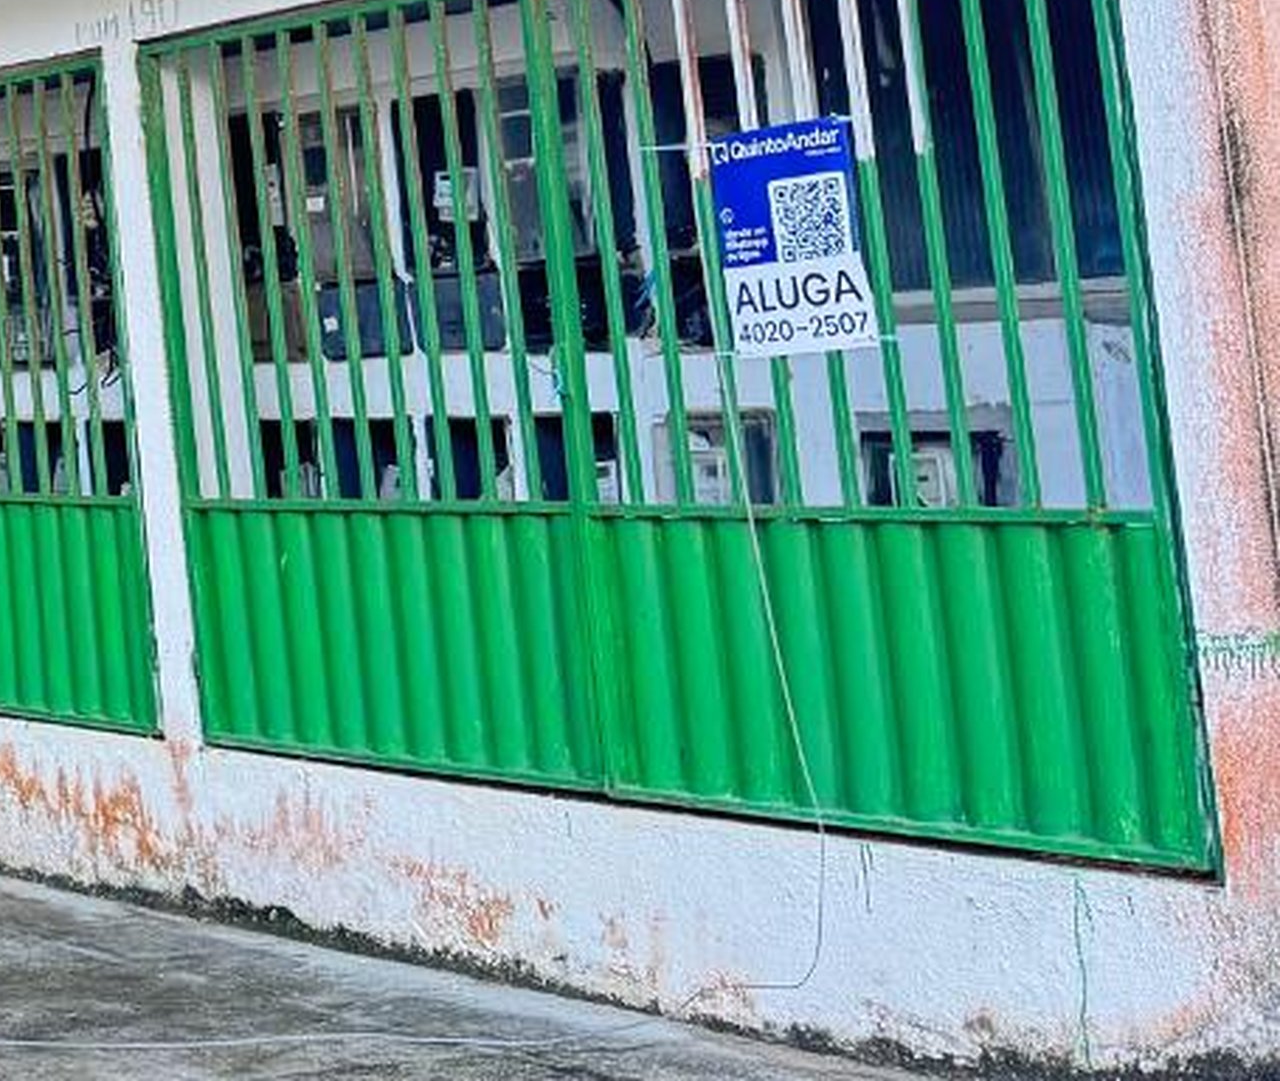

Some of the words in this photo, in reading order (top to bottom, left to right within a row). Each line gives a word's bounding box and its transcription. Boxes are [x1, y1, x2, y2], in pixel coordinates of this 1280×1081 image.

[730, 127, 840, 161] QuintoAndar
[736, 269, 864, 316] ALUGA
[739, 310, 868, 345] 4020-2507
